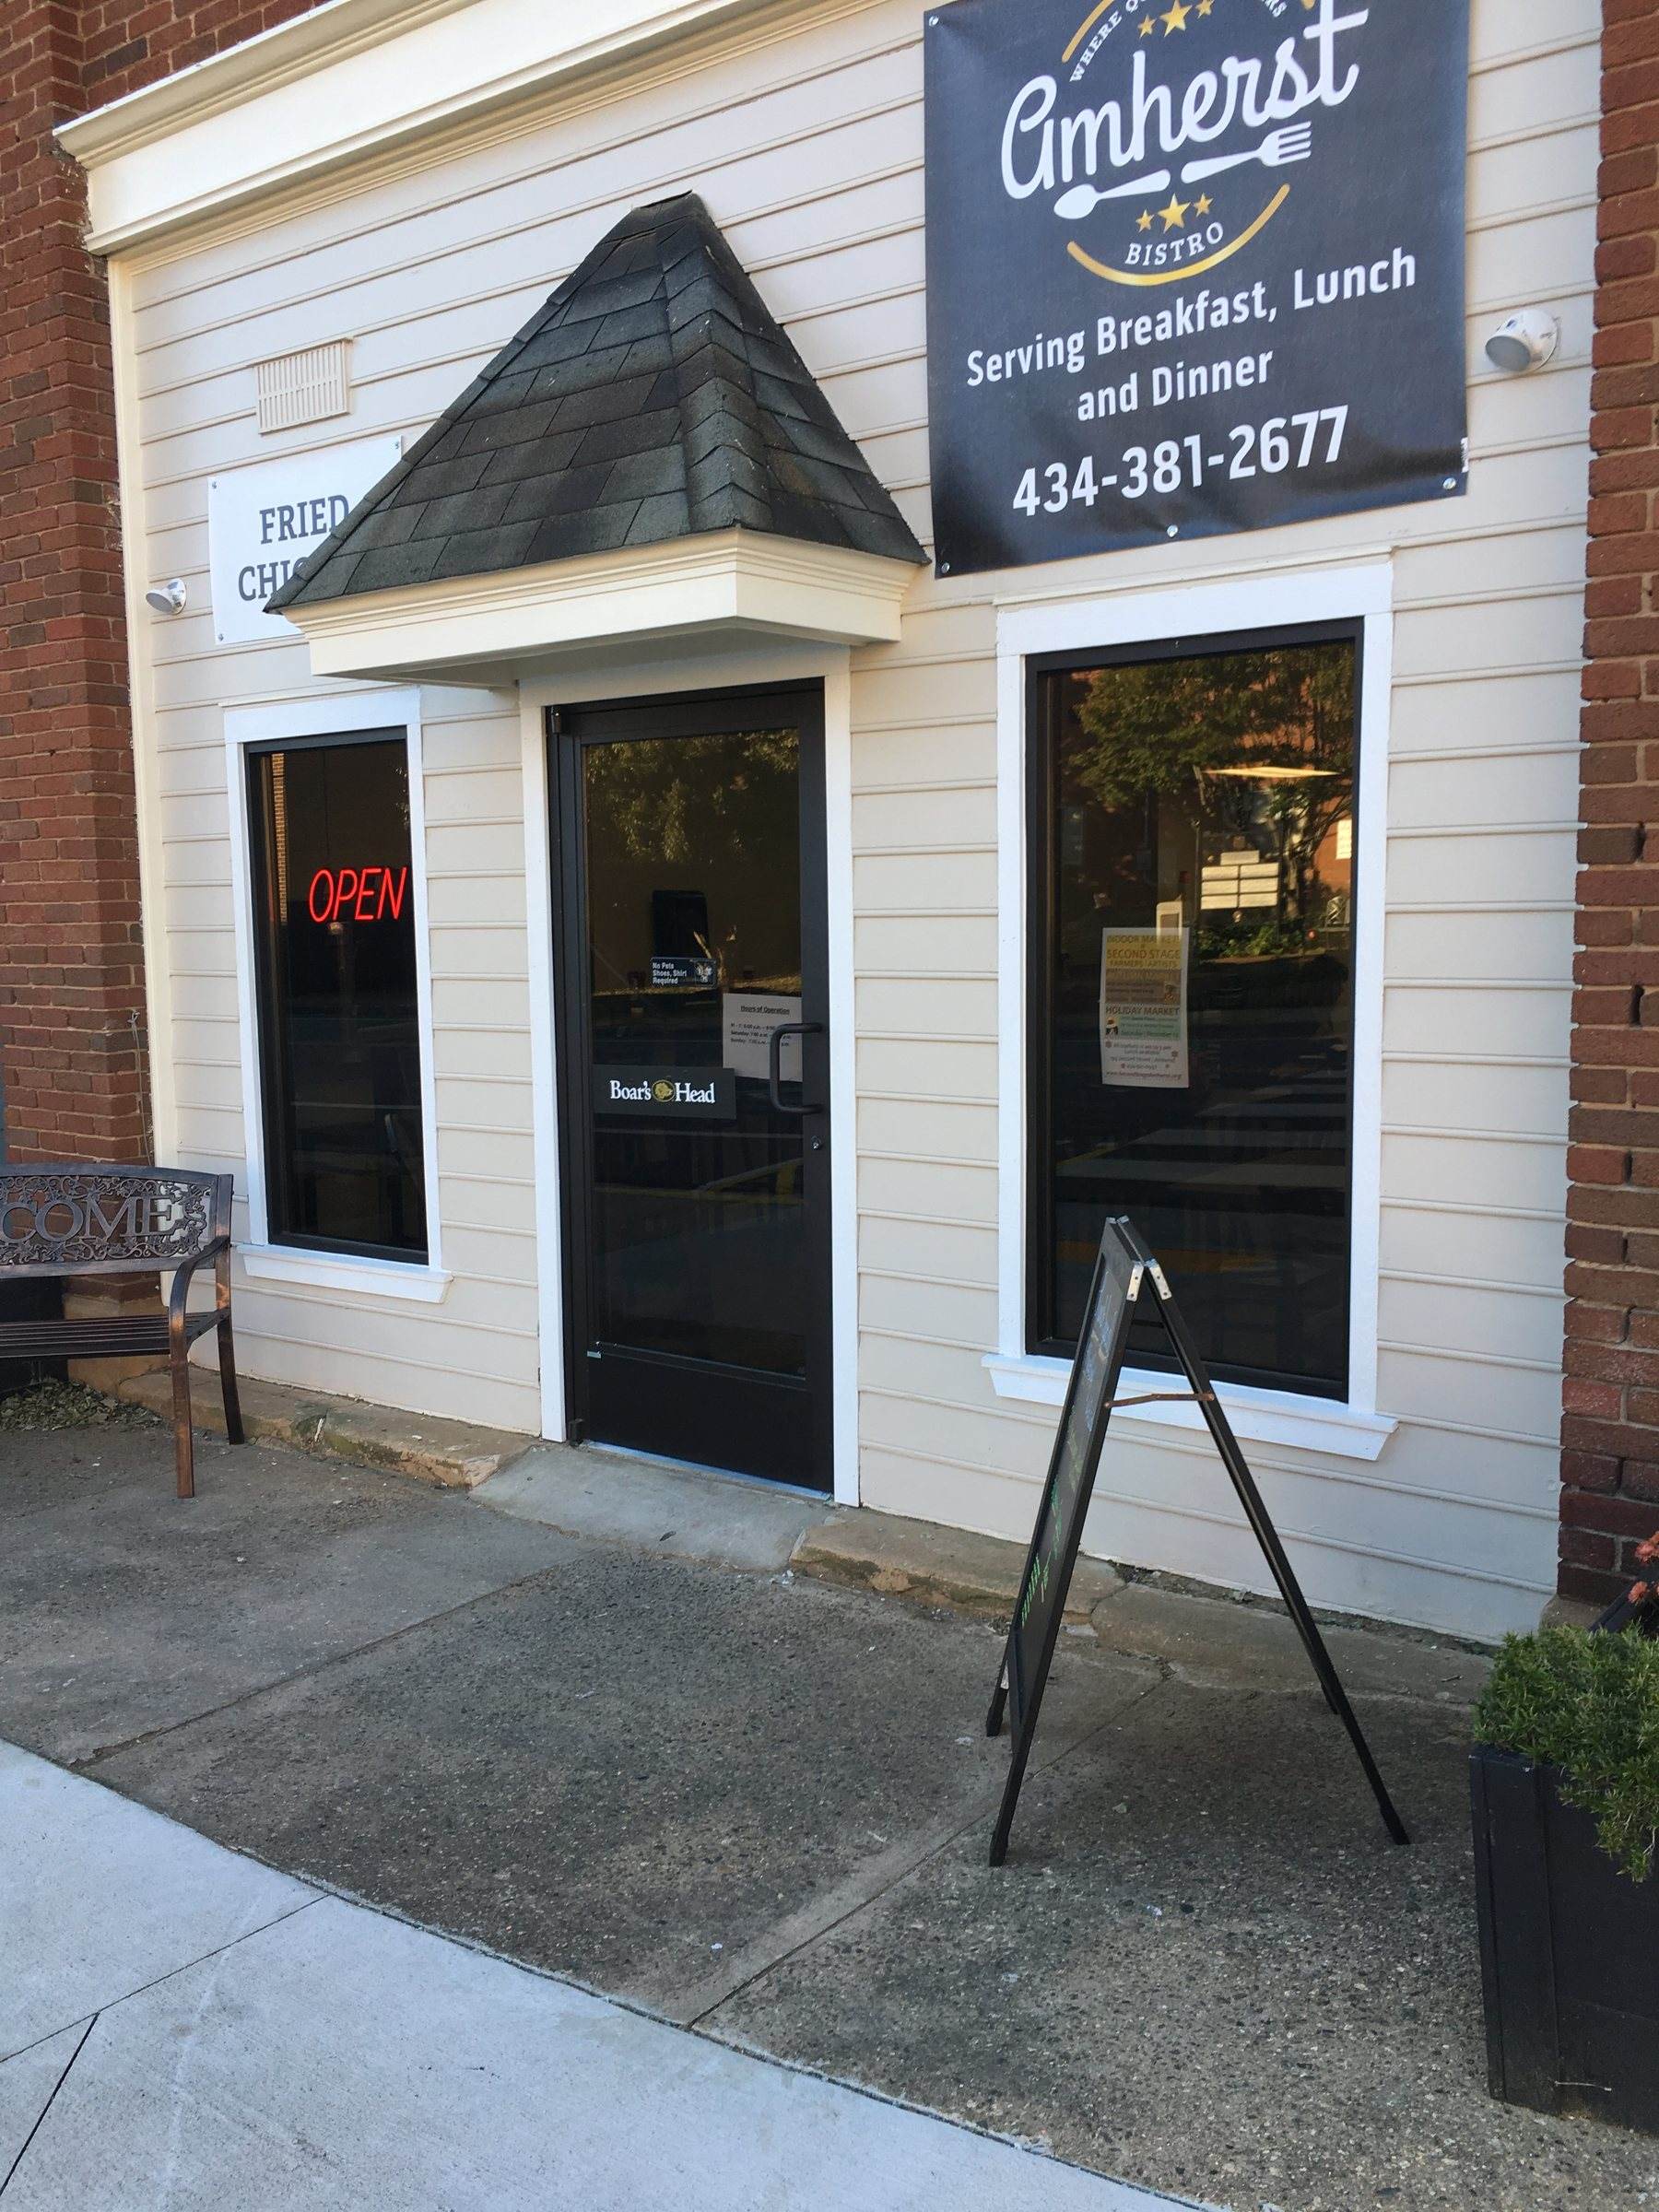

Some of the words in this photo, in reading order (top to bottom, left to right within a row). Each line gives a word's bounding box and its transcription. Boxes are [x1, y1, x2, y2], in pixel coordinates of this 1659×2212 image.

[1069, 9, 1123, 82] WHERE
[1124, 221, 1225, 267] BISTRO
[966, 326, 1086, 386] Serving
[1097, 282, 1278, 357] Breakfast,
[1293, 246, 1416, 311] Lunch
[1077, 374, 1138, 422] and
[1151, 351, 1272, 403] Dinner
[1012, 405, 1349, 516] 434-381-2677
[259, 494, 350, 545] FRIED
[309, 866, 407, 923] OPEN
[652, 961, 661, 970] No
[662, 961, 675, 970] Pets
[1106, 950, 1147, 959] SECOND
[1148, 950, 1181, 959] STAGE
[653, 976, 678, 986] Required
[673, 969, 688, 977] Shirt
[763, 1006, 790, 1015] Operation
[1106, 1006, 1142, 1015] HOLIDAY
[610, 1079, 651, 1101] Boar's
[676, 1082, 716, 1104] Head
